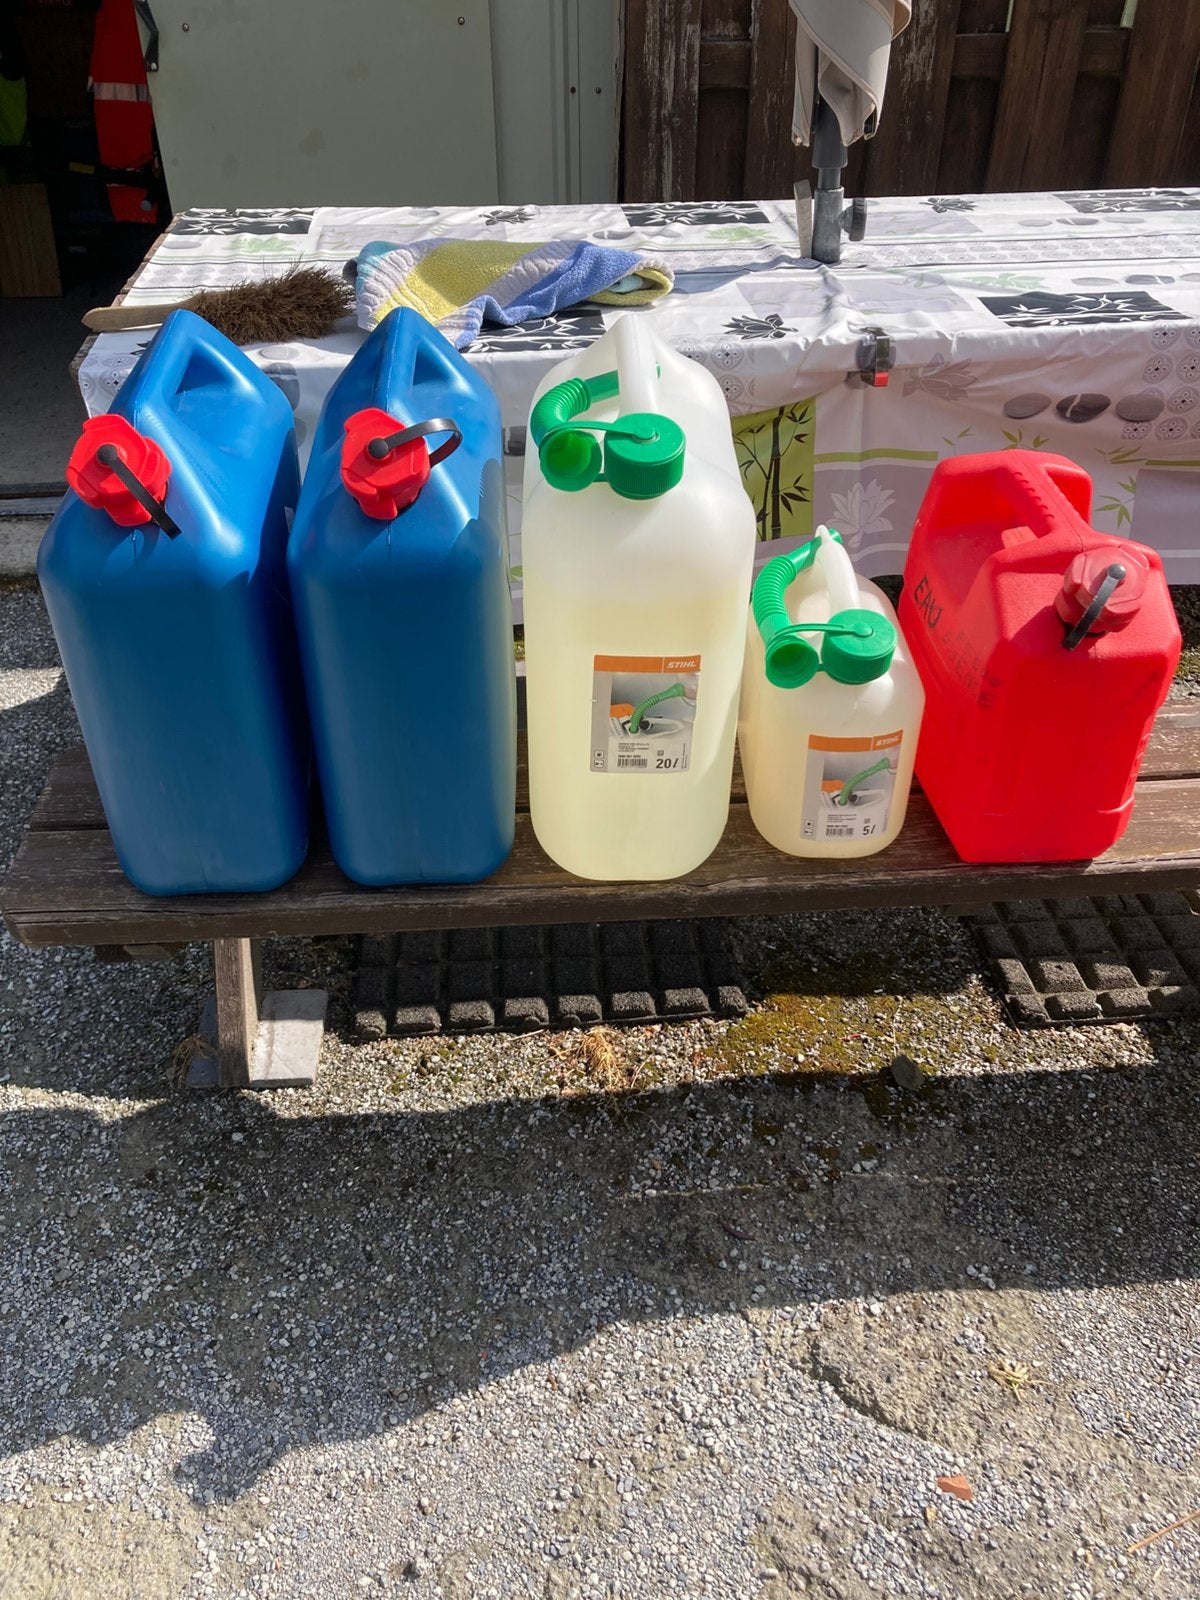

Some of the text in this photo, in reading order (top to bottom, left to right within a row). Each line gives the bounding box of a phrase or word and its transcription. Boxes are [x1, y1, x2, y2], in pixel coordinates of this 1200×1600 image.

[913, 572, 943, 628] EAU
[666, 660, 697, 669] STIHL
[875, 736, 901, 747] STIHL
